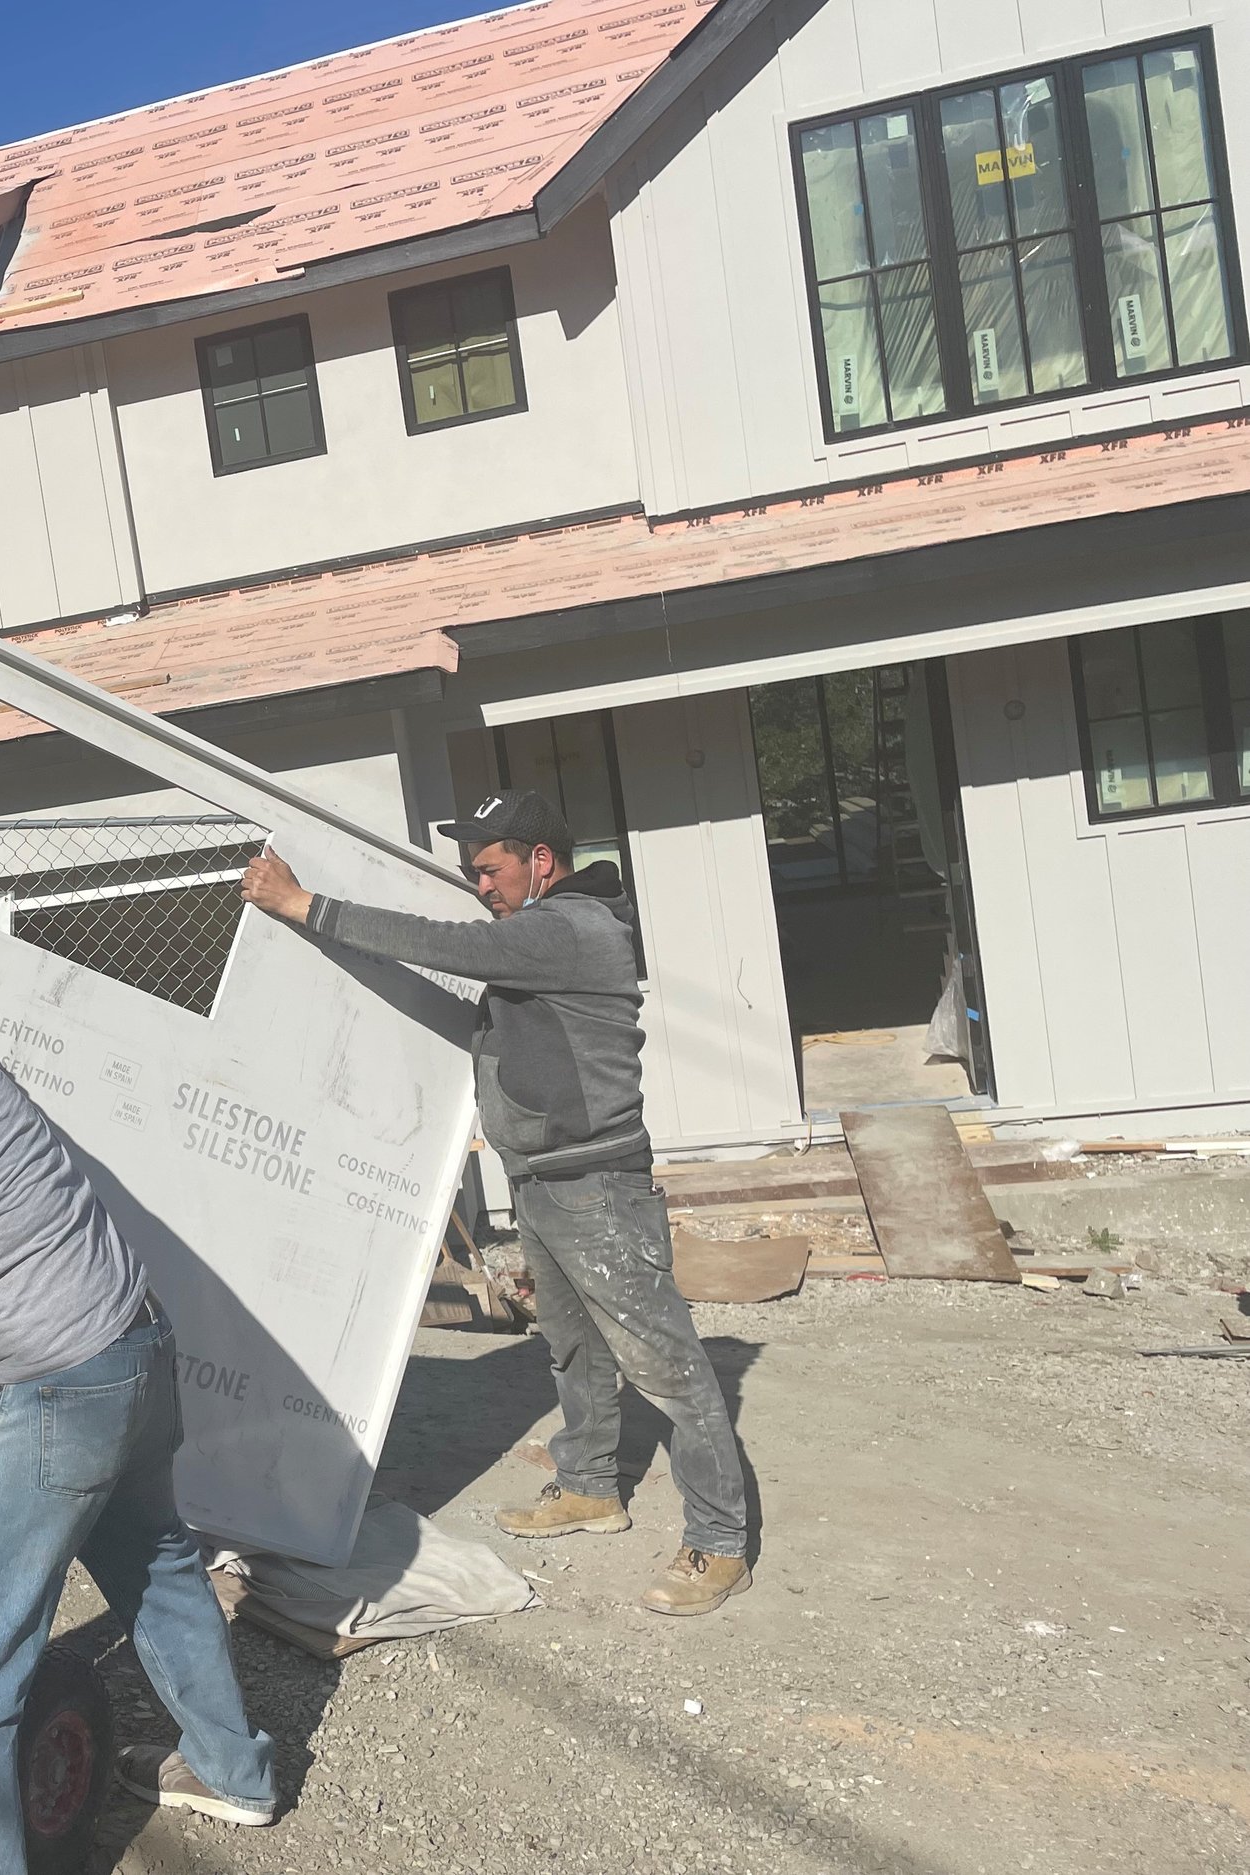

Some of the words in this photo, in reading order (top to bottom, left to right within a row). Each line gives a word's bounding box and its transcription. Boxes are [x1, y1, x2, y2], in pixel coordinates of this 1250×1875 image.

[978, 153, 1034, 174] MAVIN
[1126, 300, 1138, 336] MARVIN
[979, 333, 991, 371] MARVIN
[843, 358, 853, 395] MARVIN
[1164, 428, 1191, 441] XFR
[1102, 440, 1128, 452] XFR
[1040, 452, 1066, 464] XFR
[977, 464, 1003, 476] XFR
[917, 475, 943, 487] XFR
[857, 486, 883, 497] XFR
[800, 497, 825, 508] XFR
[743, 507, 767, 518] XFR
[686, 518, 711, 528] XFR
[55, 625, 82, 633] POLYSTICK
[112, 1060, 132, 1074] MADE
[104, 1068, 114, 1078] IN
[114, 1072, 134, 1086] SPAIN
[122, 1102, 142, 1116] MADE
[114, 1109, 124, 1119] IN
[123, 1112, 144, 1126] SPAIN
[172, 1083, 307, 1157] SILESTONE
[183, 1123, 316, 1195] SILESTONE
[338, 1153, 421, 1197] COSENTINO
[283, 1395, 368, 1434] COSENTINO
